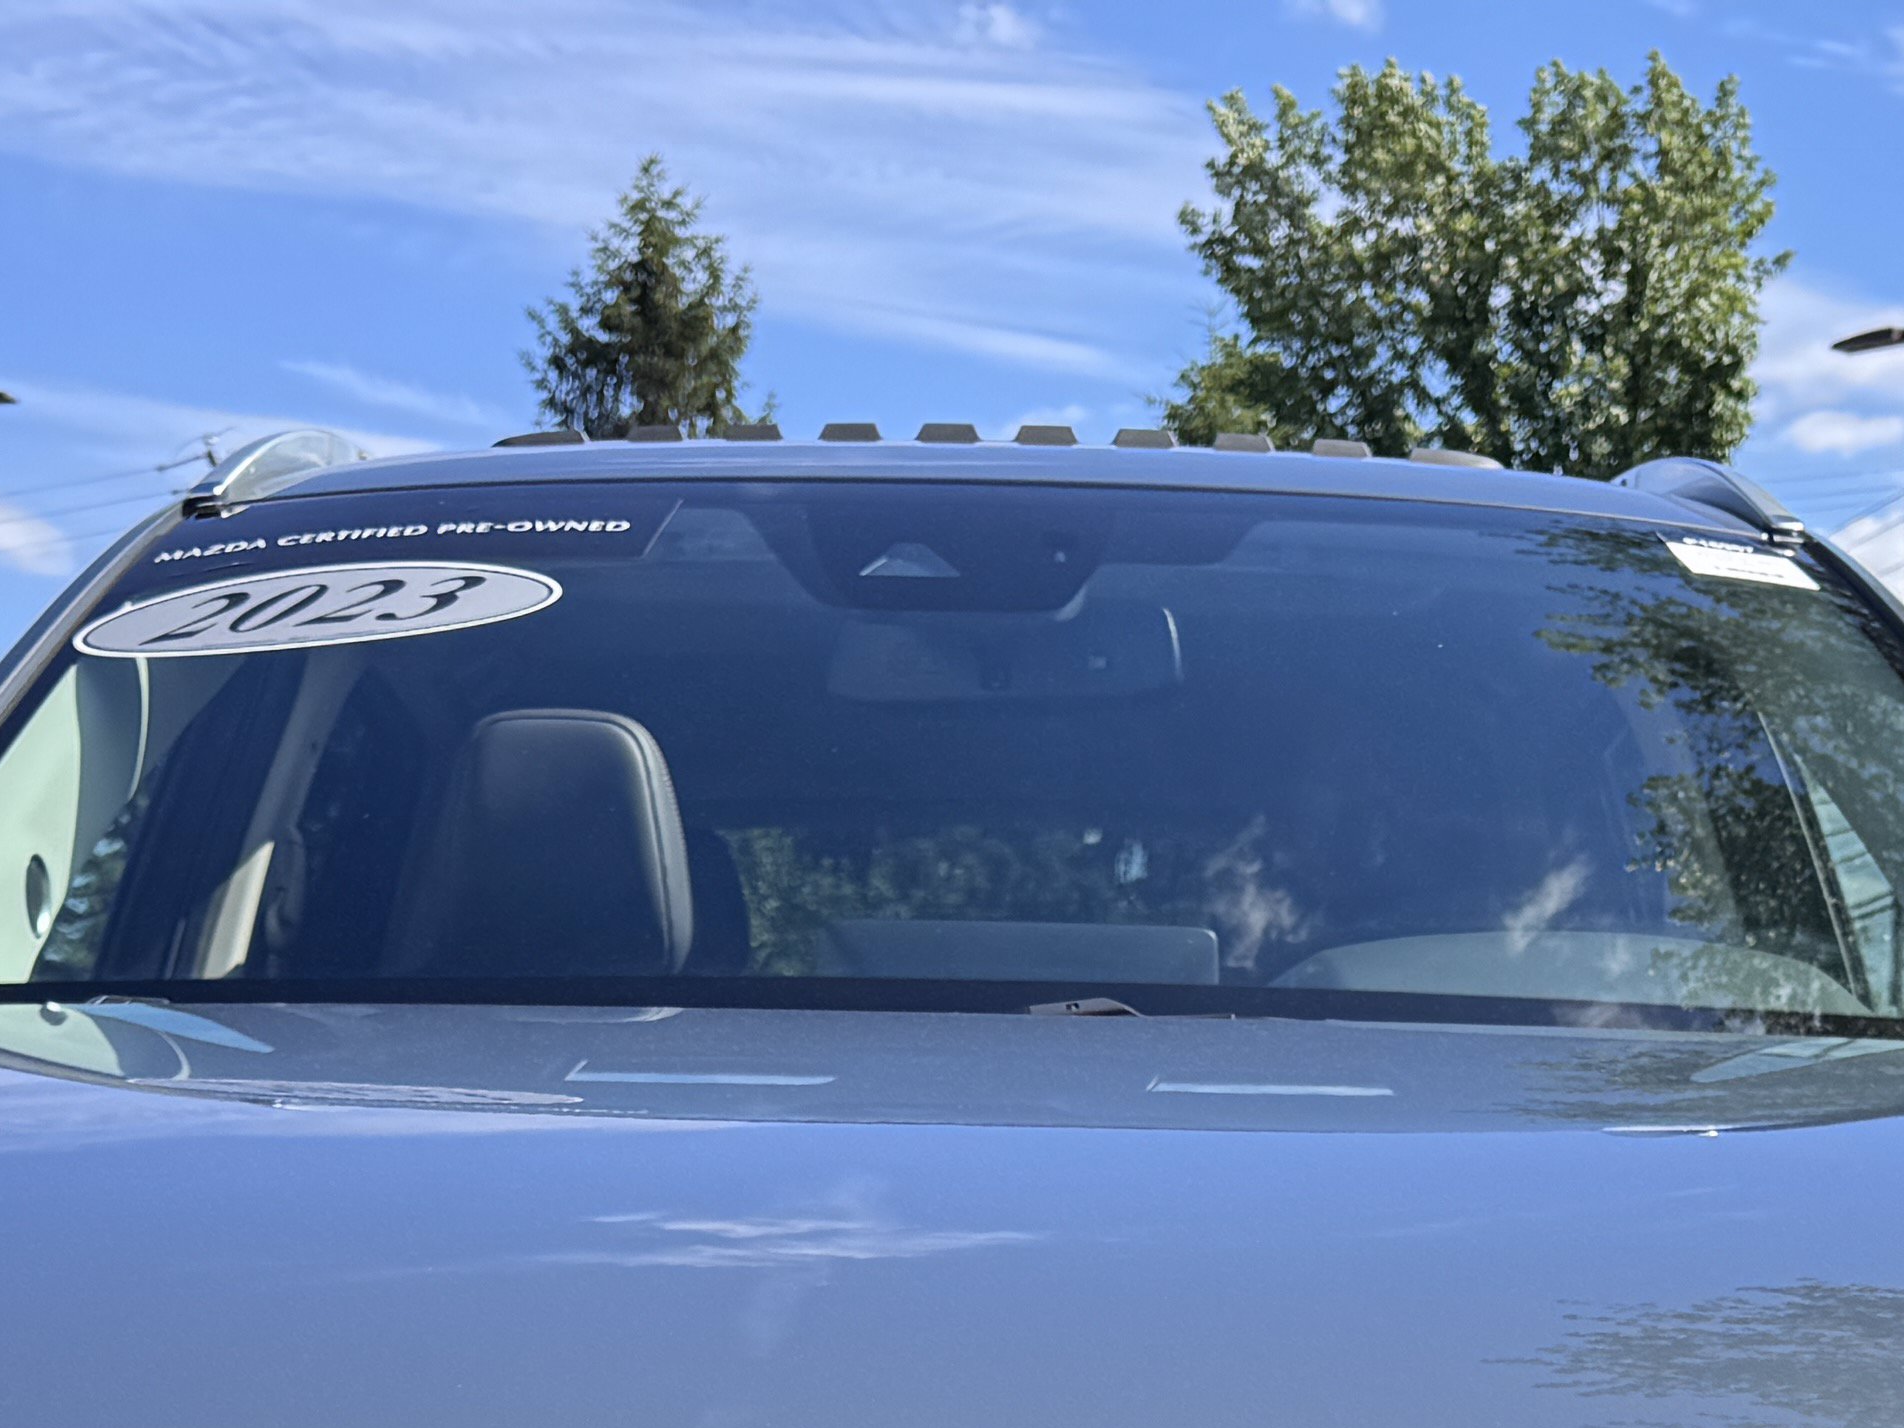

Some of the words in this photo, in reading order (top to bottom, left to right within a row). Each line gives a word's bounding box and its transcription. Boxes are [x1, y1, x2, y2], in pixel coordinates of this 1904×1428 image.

[153, 537, 267, 564] MAZDA
[277, 523, 429, 548] CERTIFIED
[436, 519, 632, 535] PRE-OWNED
[137, 574, 487, 647] 2023
